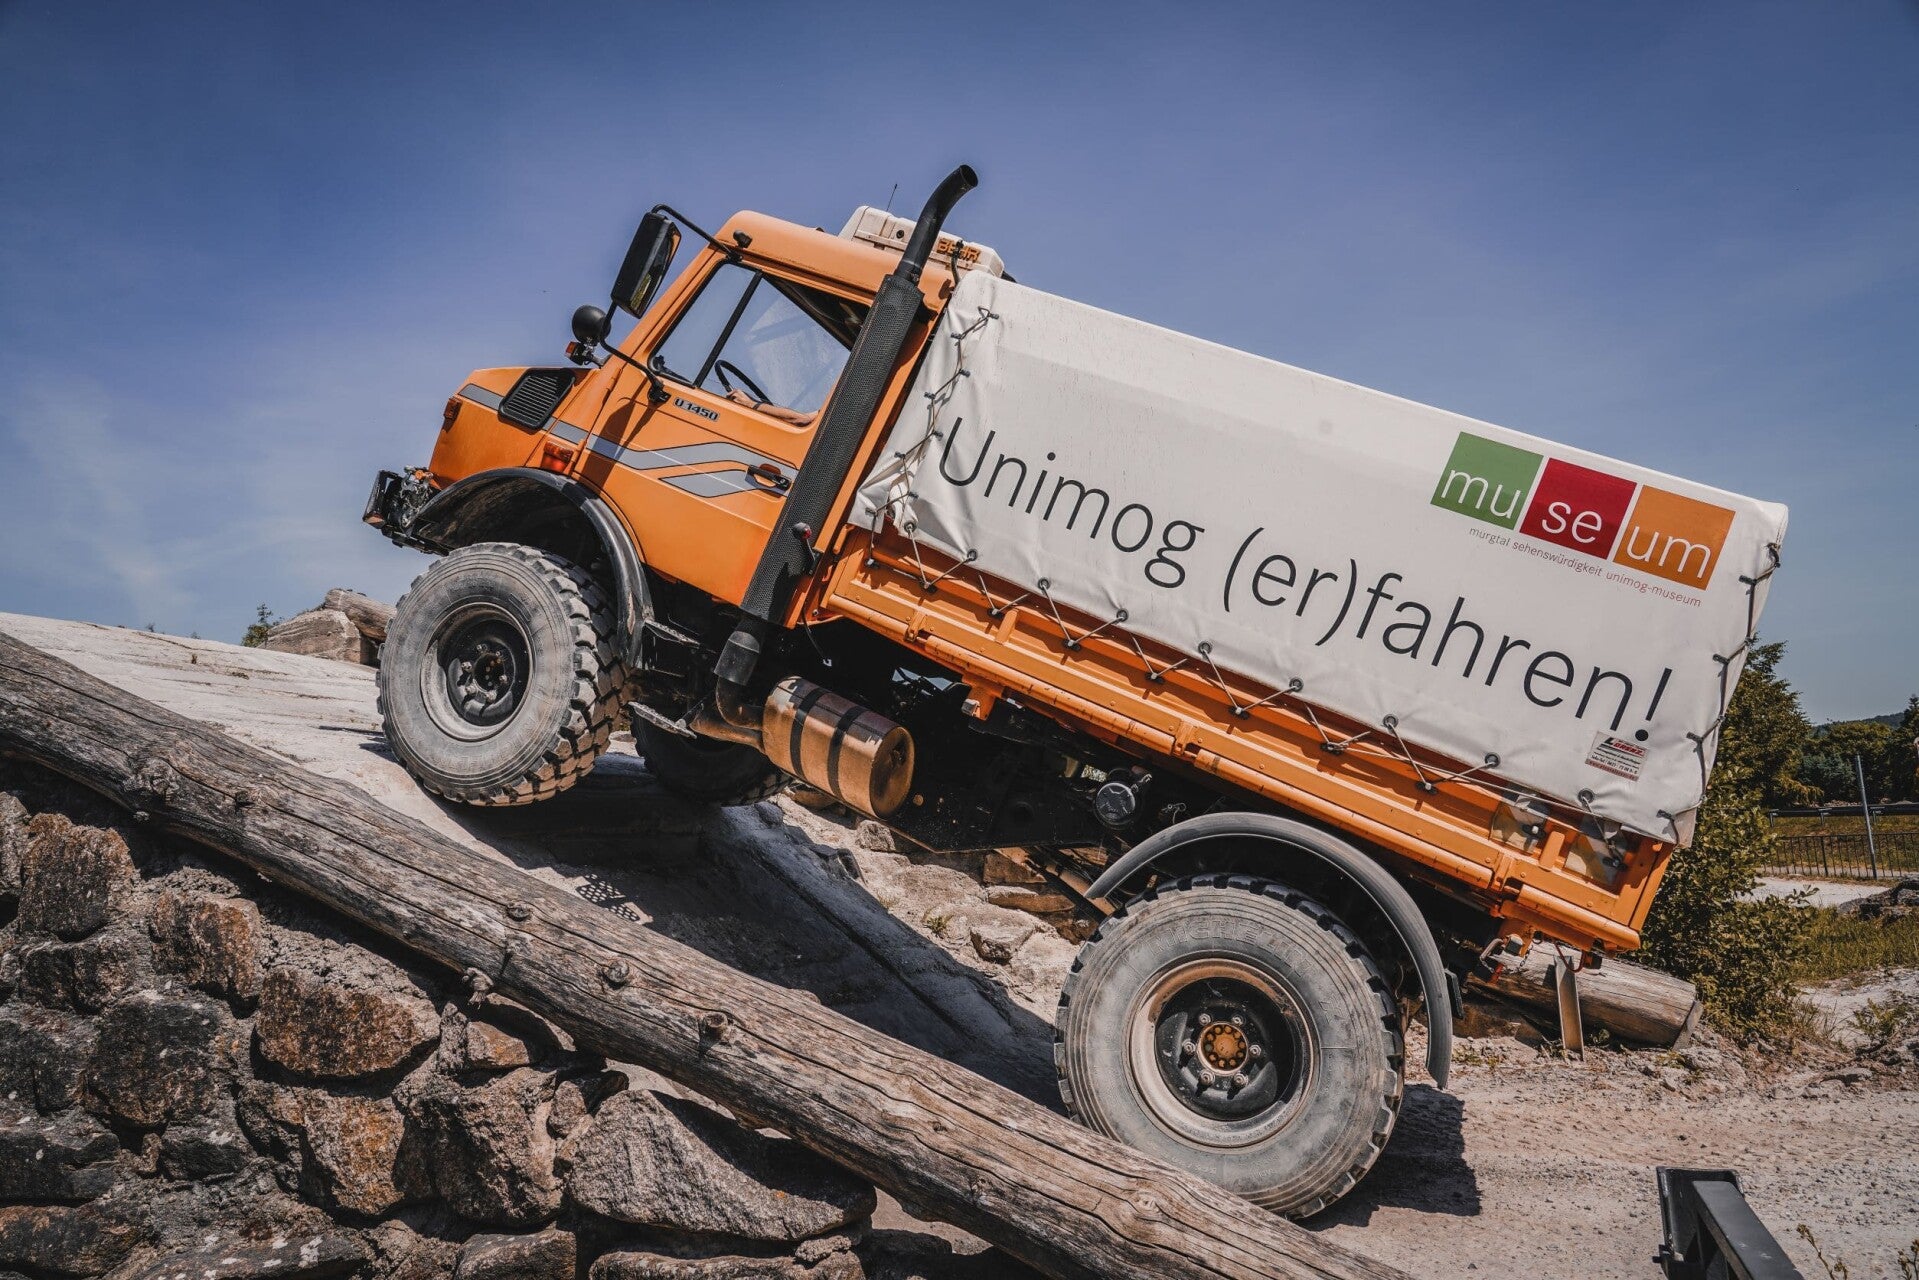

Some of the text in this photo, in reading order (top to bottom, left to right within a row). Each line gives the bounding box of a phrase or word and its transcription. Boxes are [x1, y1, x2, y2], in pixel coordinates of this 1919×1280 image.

[687, 402, 718, 421] 1450
[939, 417, 1671, 742] Unimog (er)fahren!
[1469, 526, 1701, 608] murgtal sehenswürdigkeit unimog-museum
